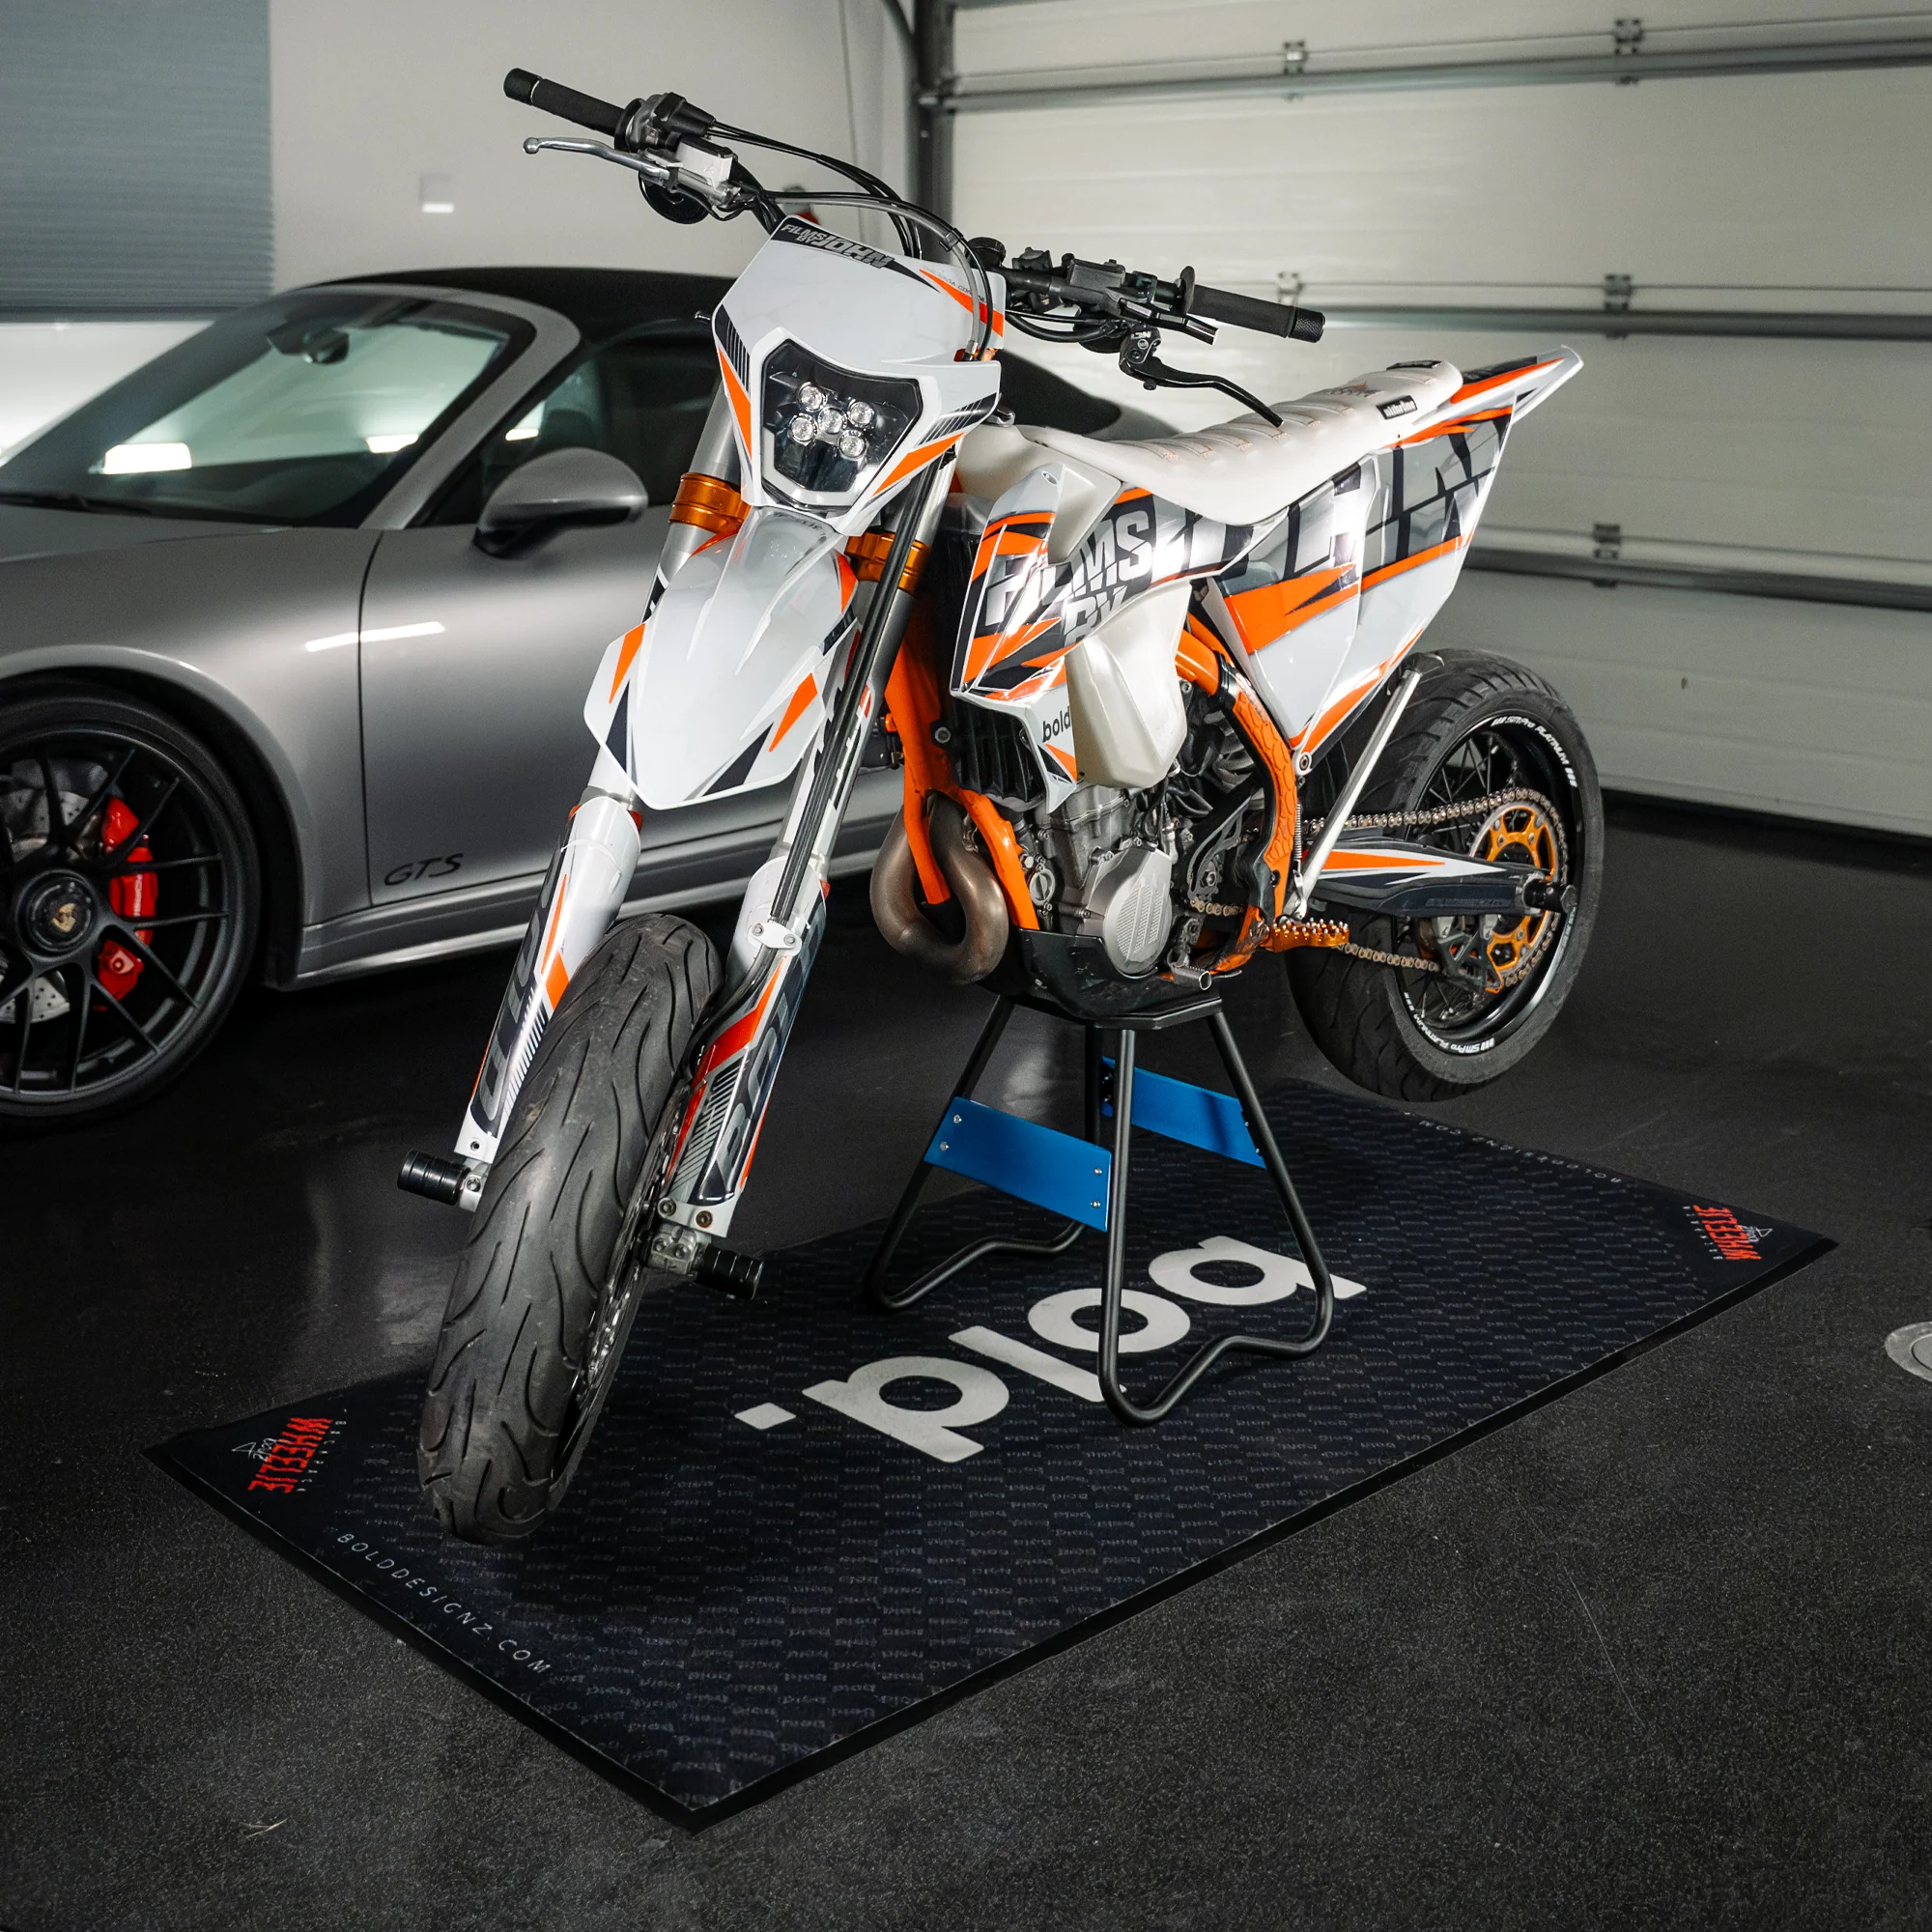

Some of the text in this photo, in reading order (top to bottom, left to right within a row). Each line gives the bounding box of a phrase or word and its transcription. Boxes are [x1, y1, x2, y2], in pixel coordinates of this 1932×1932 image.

[781, 224, 826, 241] FILMS
[810, 236, 895, 270] JOHN
[1042, 705, 1071, 743] bold
[384, 852, 464, 886] GTS
[1692, 1205, 1763, 1261] WHEELIE
[247, 1417, 333, 1493] WHEELIE
